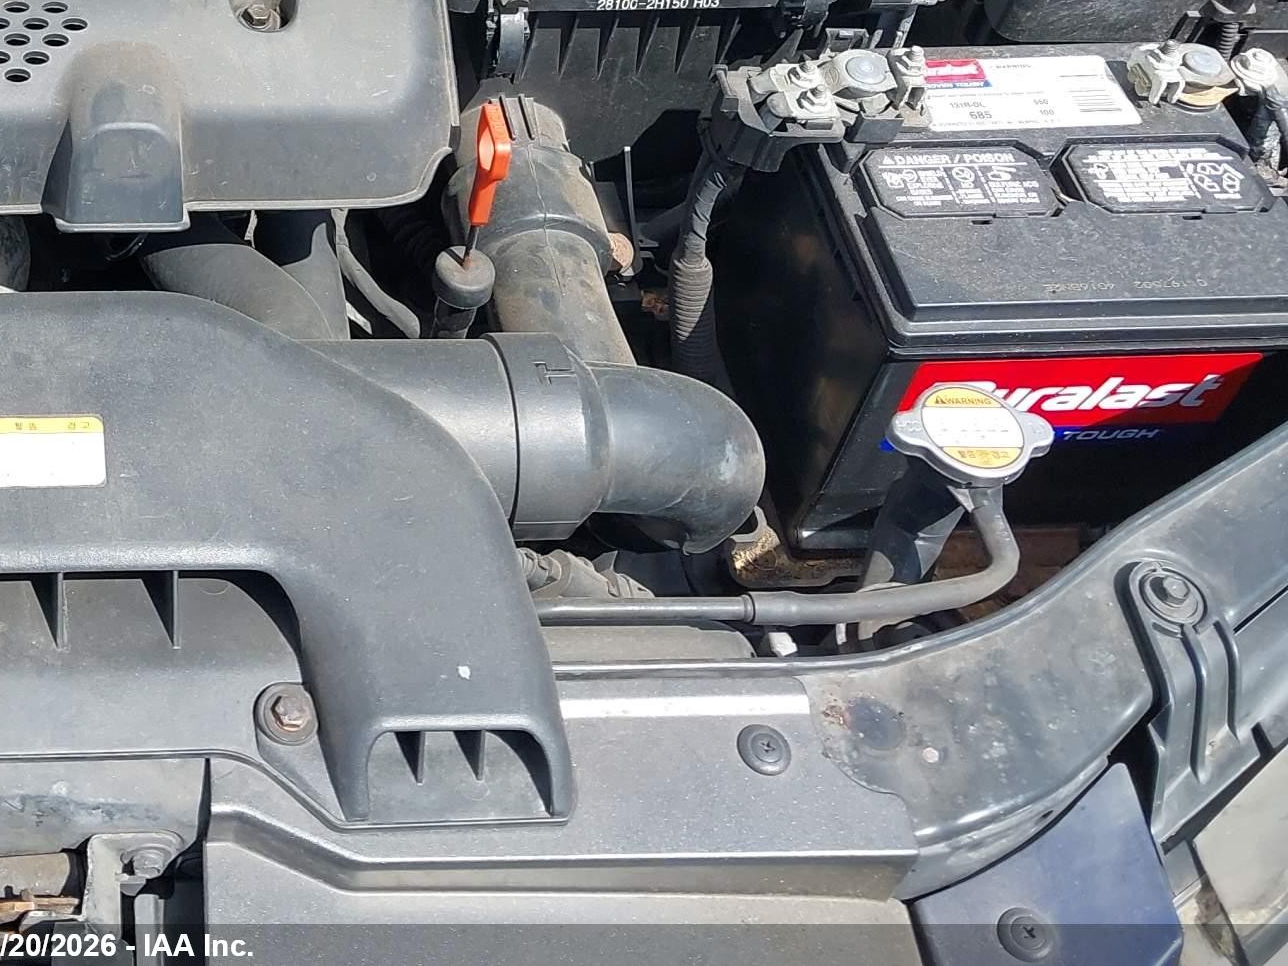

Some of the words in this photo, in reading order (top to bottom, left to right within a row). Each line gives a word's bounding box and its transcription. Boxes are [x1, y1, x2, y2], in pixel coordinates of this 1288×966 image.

[969, 110, 993, 120] 685
[894, 153, 951, 165] DANGER
[964, 152, 1015, 164] POISON
[946, 396, 992, 406] WARNING
[1063, 428, 1162, 441] TOUGH
